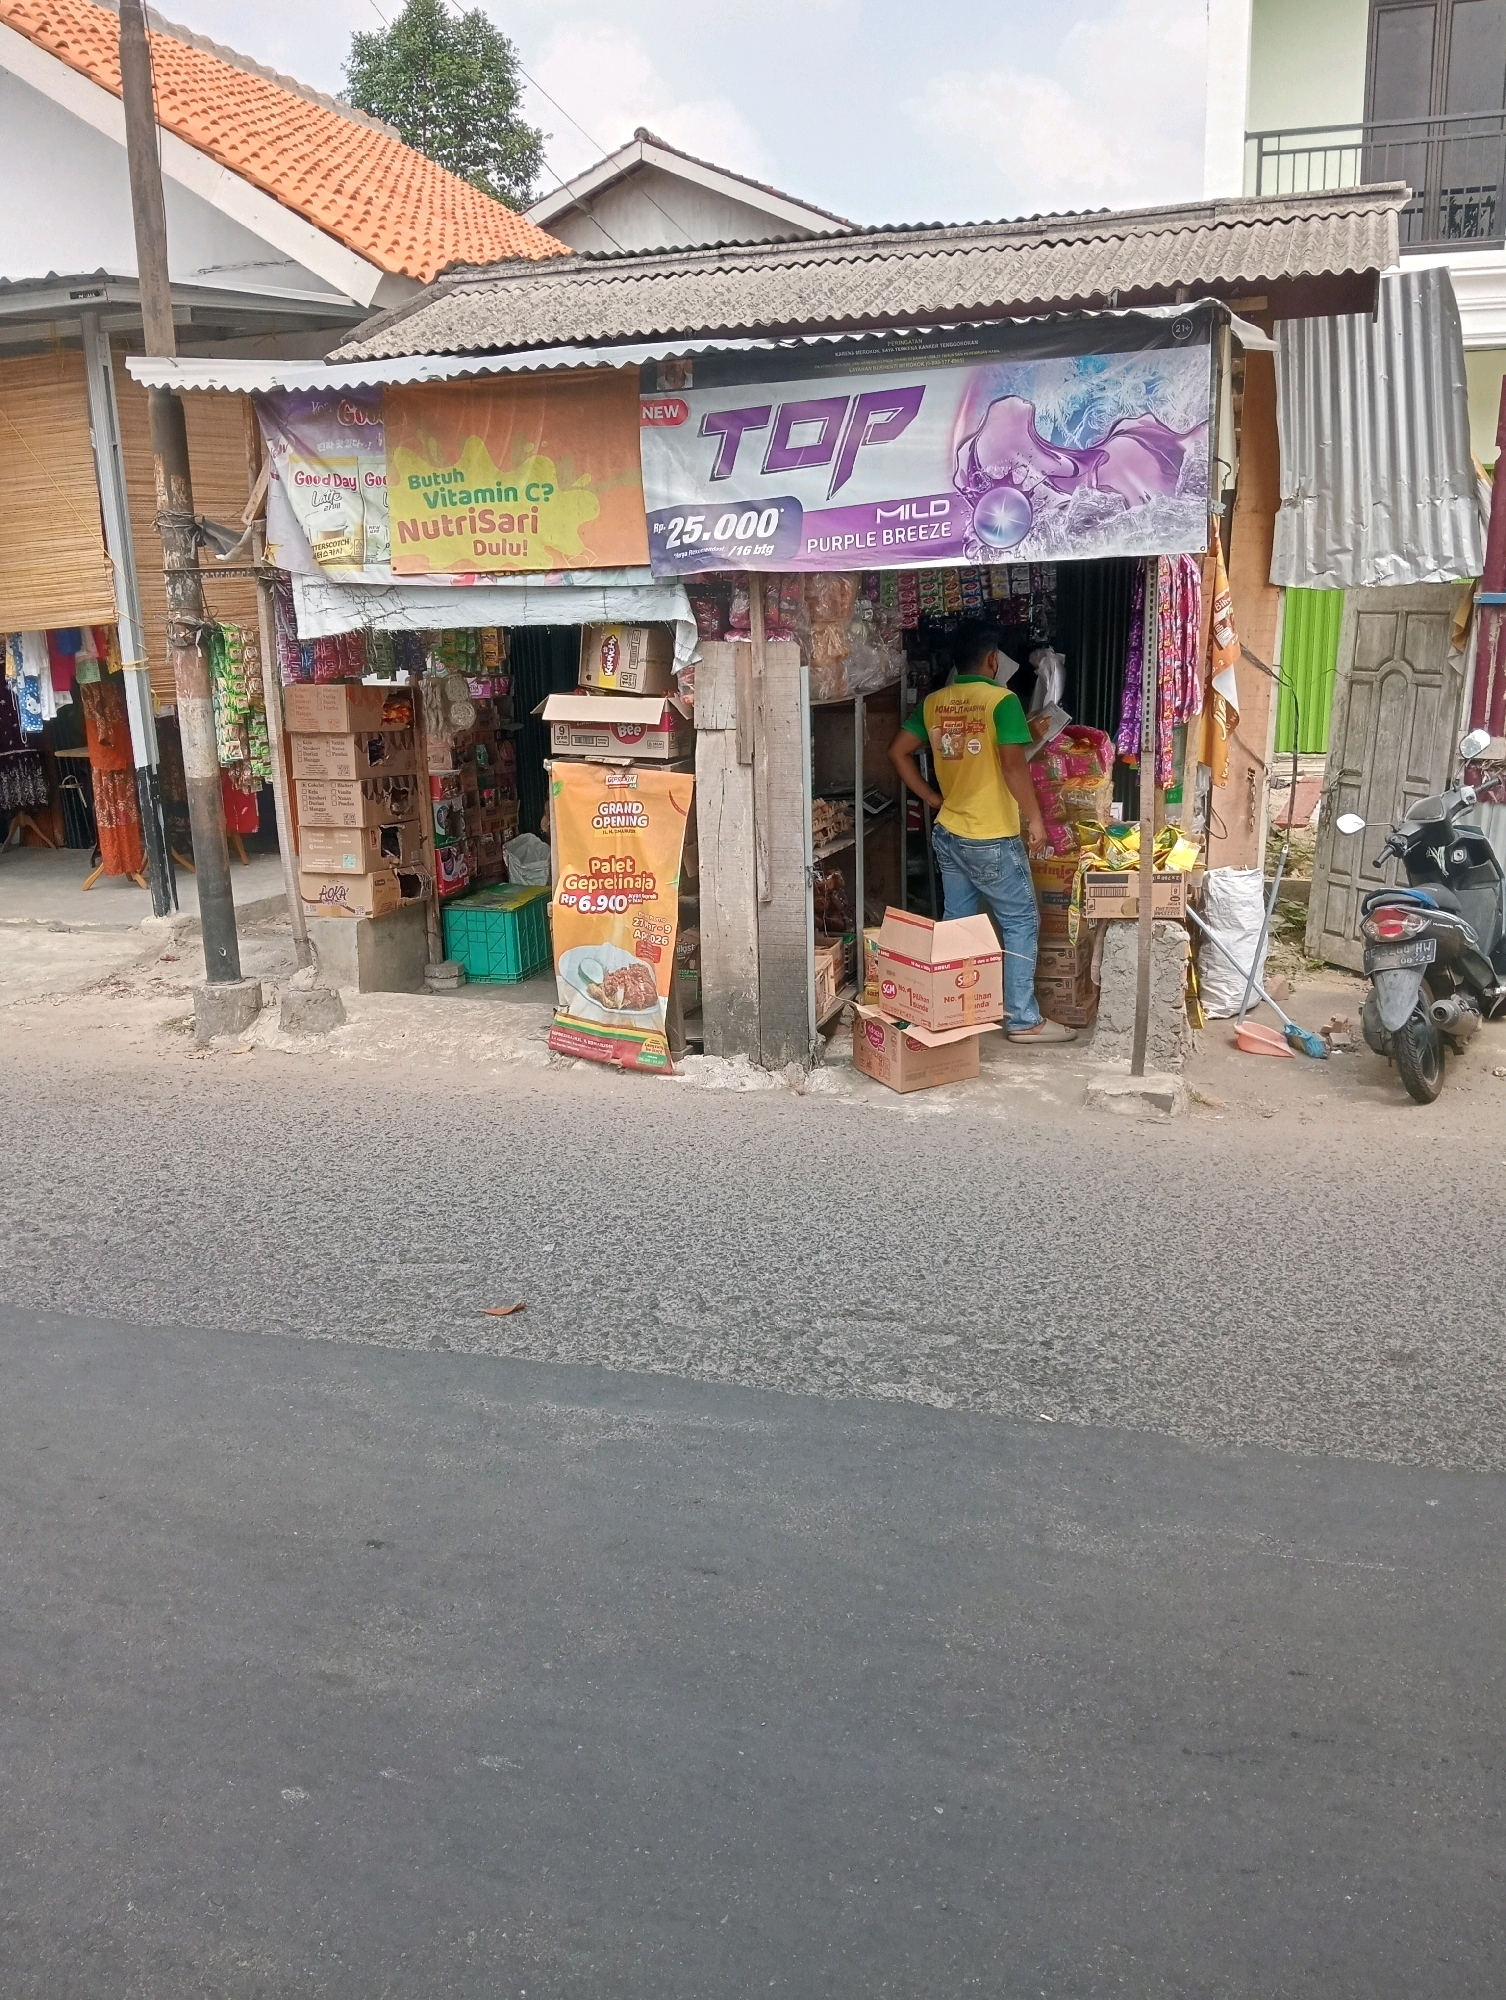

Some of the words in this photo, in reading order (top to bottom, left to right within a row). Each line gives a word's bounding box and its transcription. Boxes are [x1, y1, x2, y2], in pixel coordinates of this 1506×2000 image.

[1176, 324, 1190, 332] 21+
[642, 404, 680, 422] NEW
[700, 385, 926, 500] TOP
[294, 470, 330, 486] Good
[332, 473, 357, 492] Day
[408, 468, 464, 490] Butuh
[312, 490, 342, 508] Latte
[422, 482, 519, 510] Vitamin
[524, 482, 554, 503] C?
[876, 500, 950, 524] MILD
[397, 506, 539, 544] NutriSari
[807, 531, 876, 553] PURPLE
[882, 522, 952, 546] BREEZE
[473, 538, 528, 558] Dulu!
[728, 546, 752, 556] /16
[753, 544, 775, 556] btg
[558, 726, 565, 735] 9
[600, 802, 643, 815] GRAND
[593, 816, 648, 828] OPENING
[560, 894, 577, 905] Rp
[664, 925, 672, 933] 9
[1416, 942, 1432, 952] HW
[882, 984, 895, 994] SGM
[898, 984, 906, 993] No.
[907, 988, 912, 1006] 1
[913, 1002, 928, 1012] Bunda
[958, 994, 964, 1011] 1
